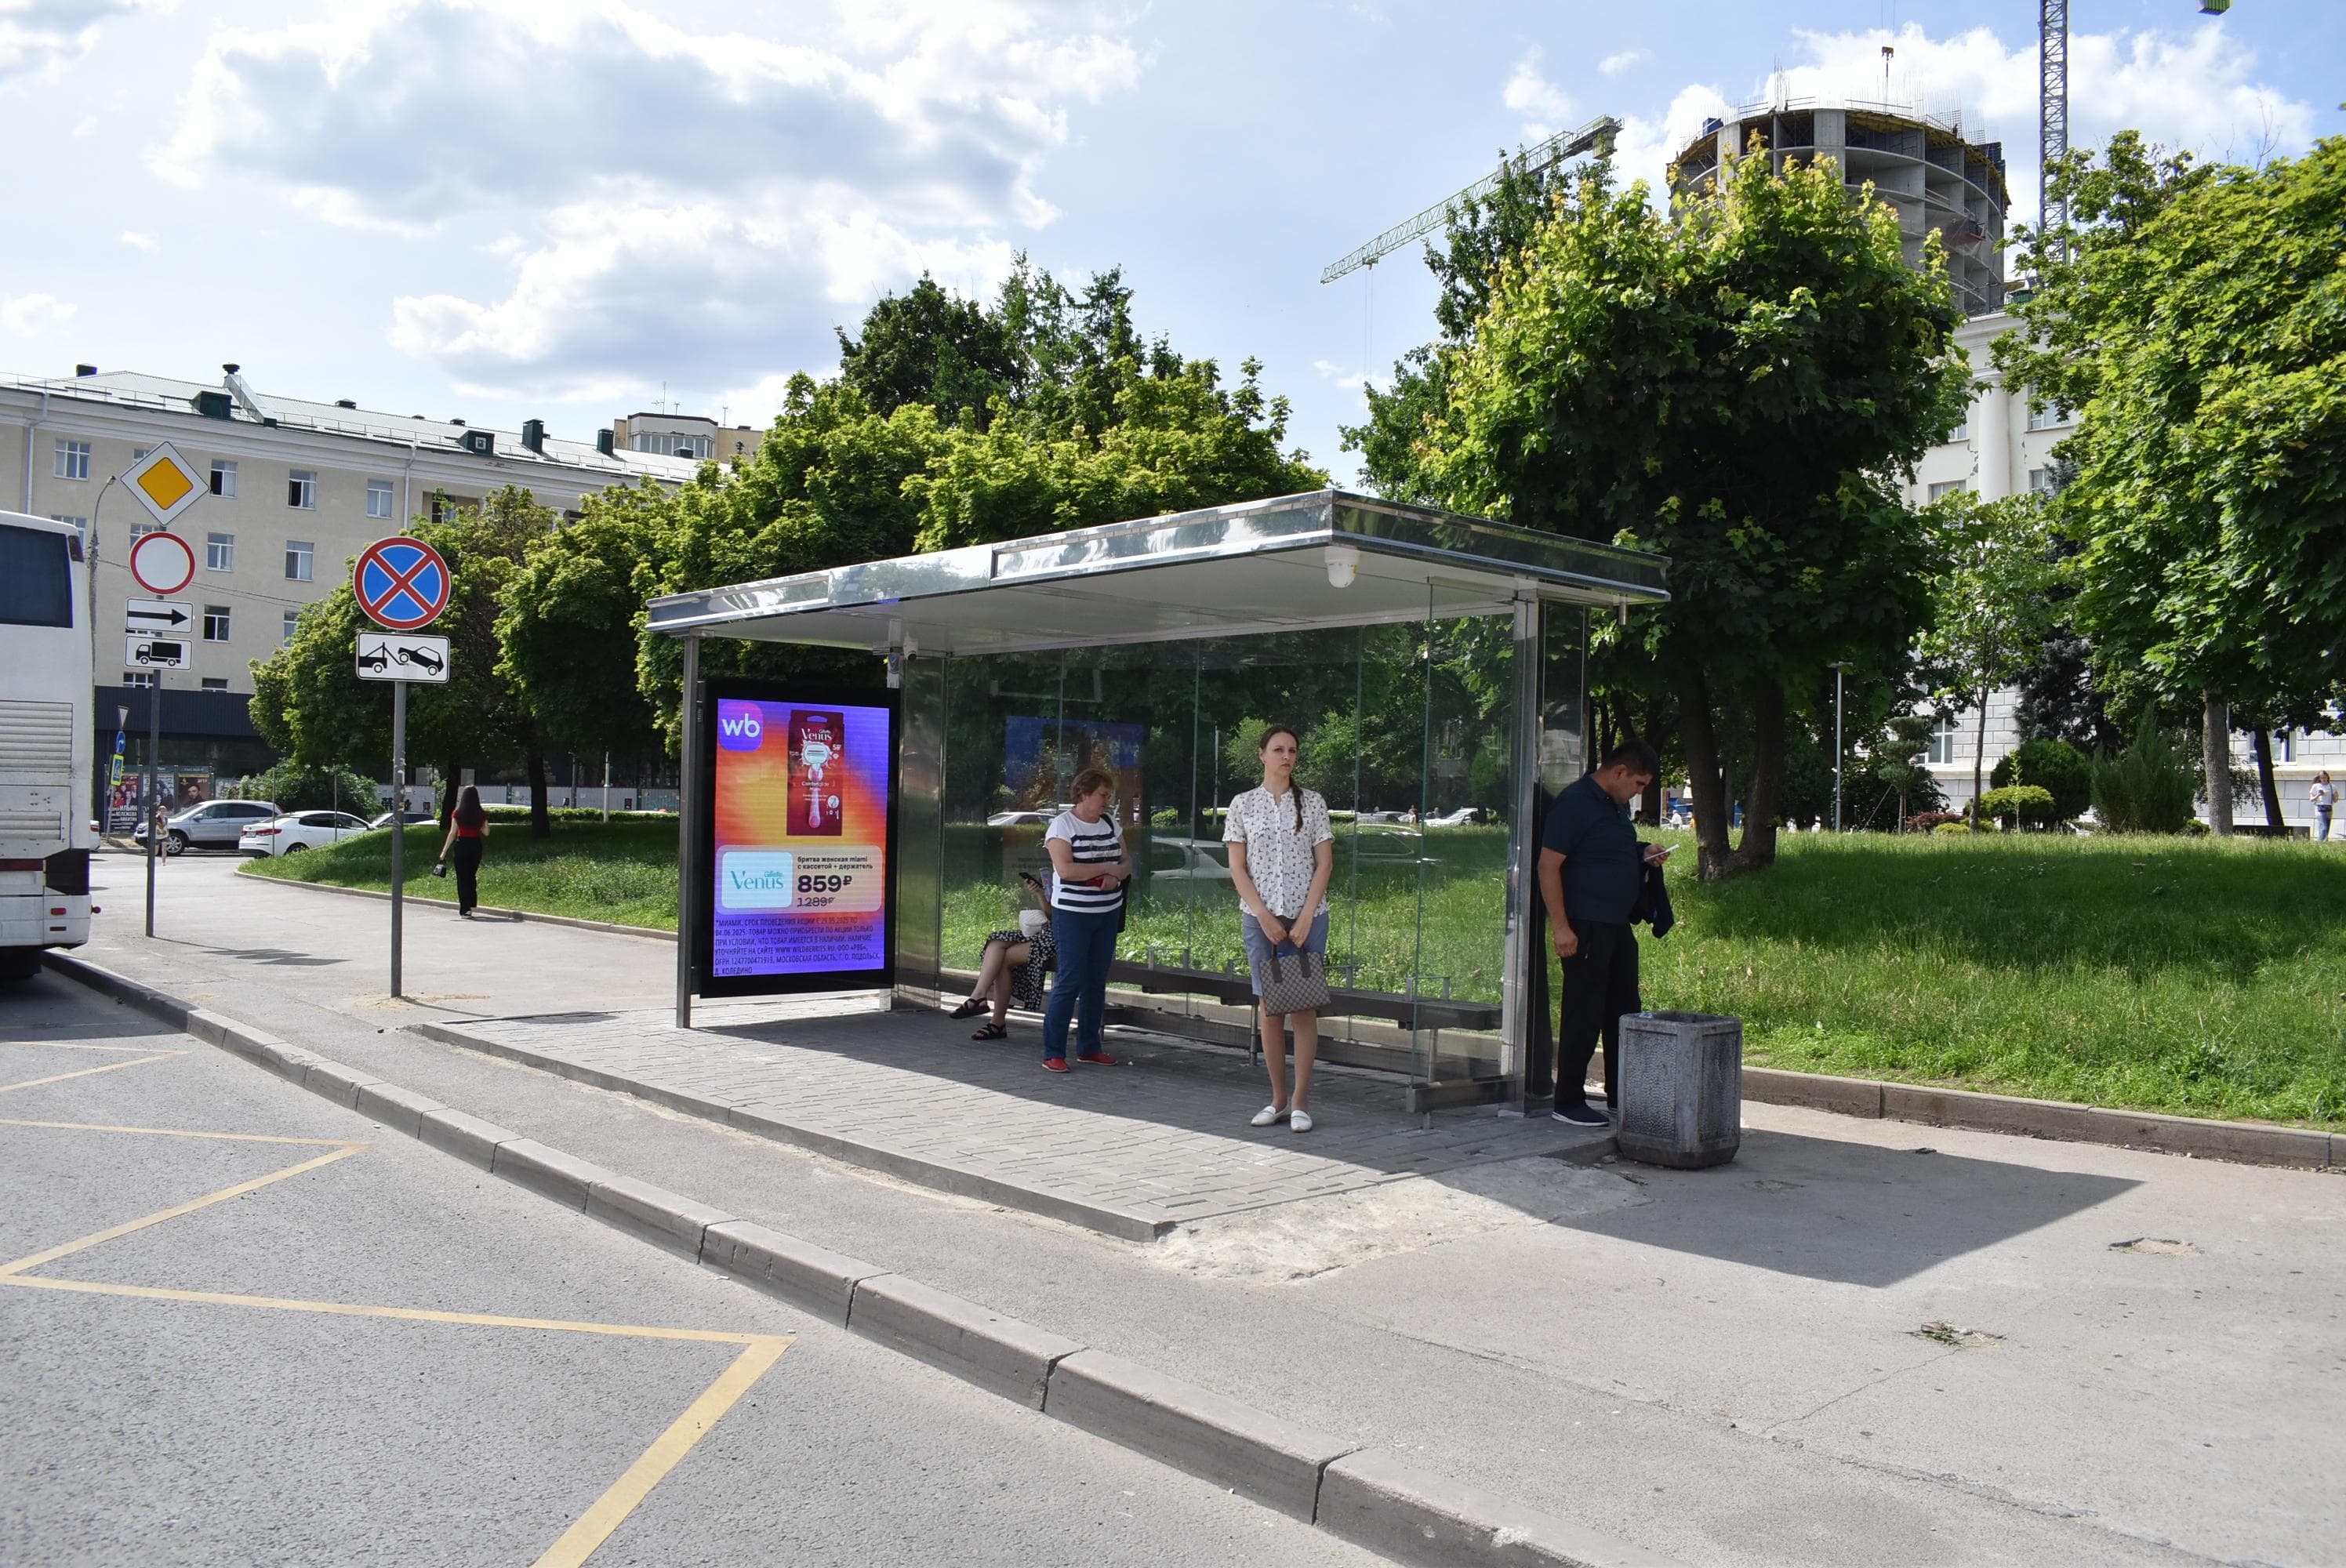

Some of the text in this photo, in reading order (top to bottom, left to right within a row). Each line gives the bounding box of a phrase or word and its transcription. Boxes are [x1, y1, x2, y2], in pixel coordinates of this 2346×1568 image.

[722, 713, 760, 738] wb
[801, 728, 833, 741] Venus
[731, 871, 783, 890] Venus
